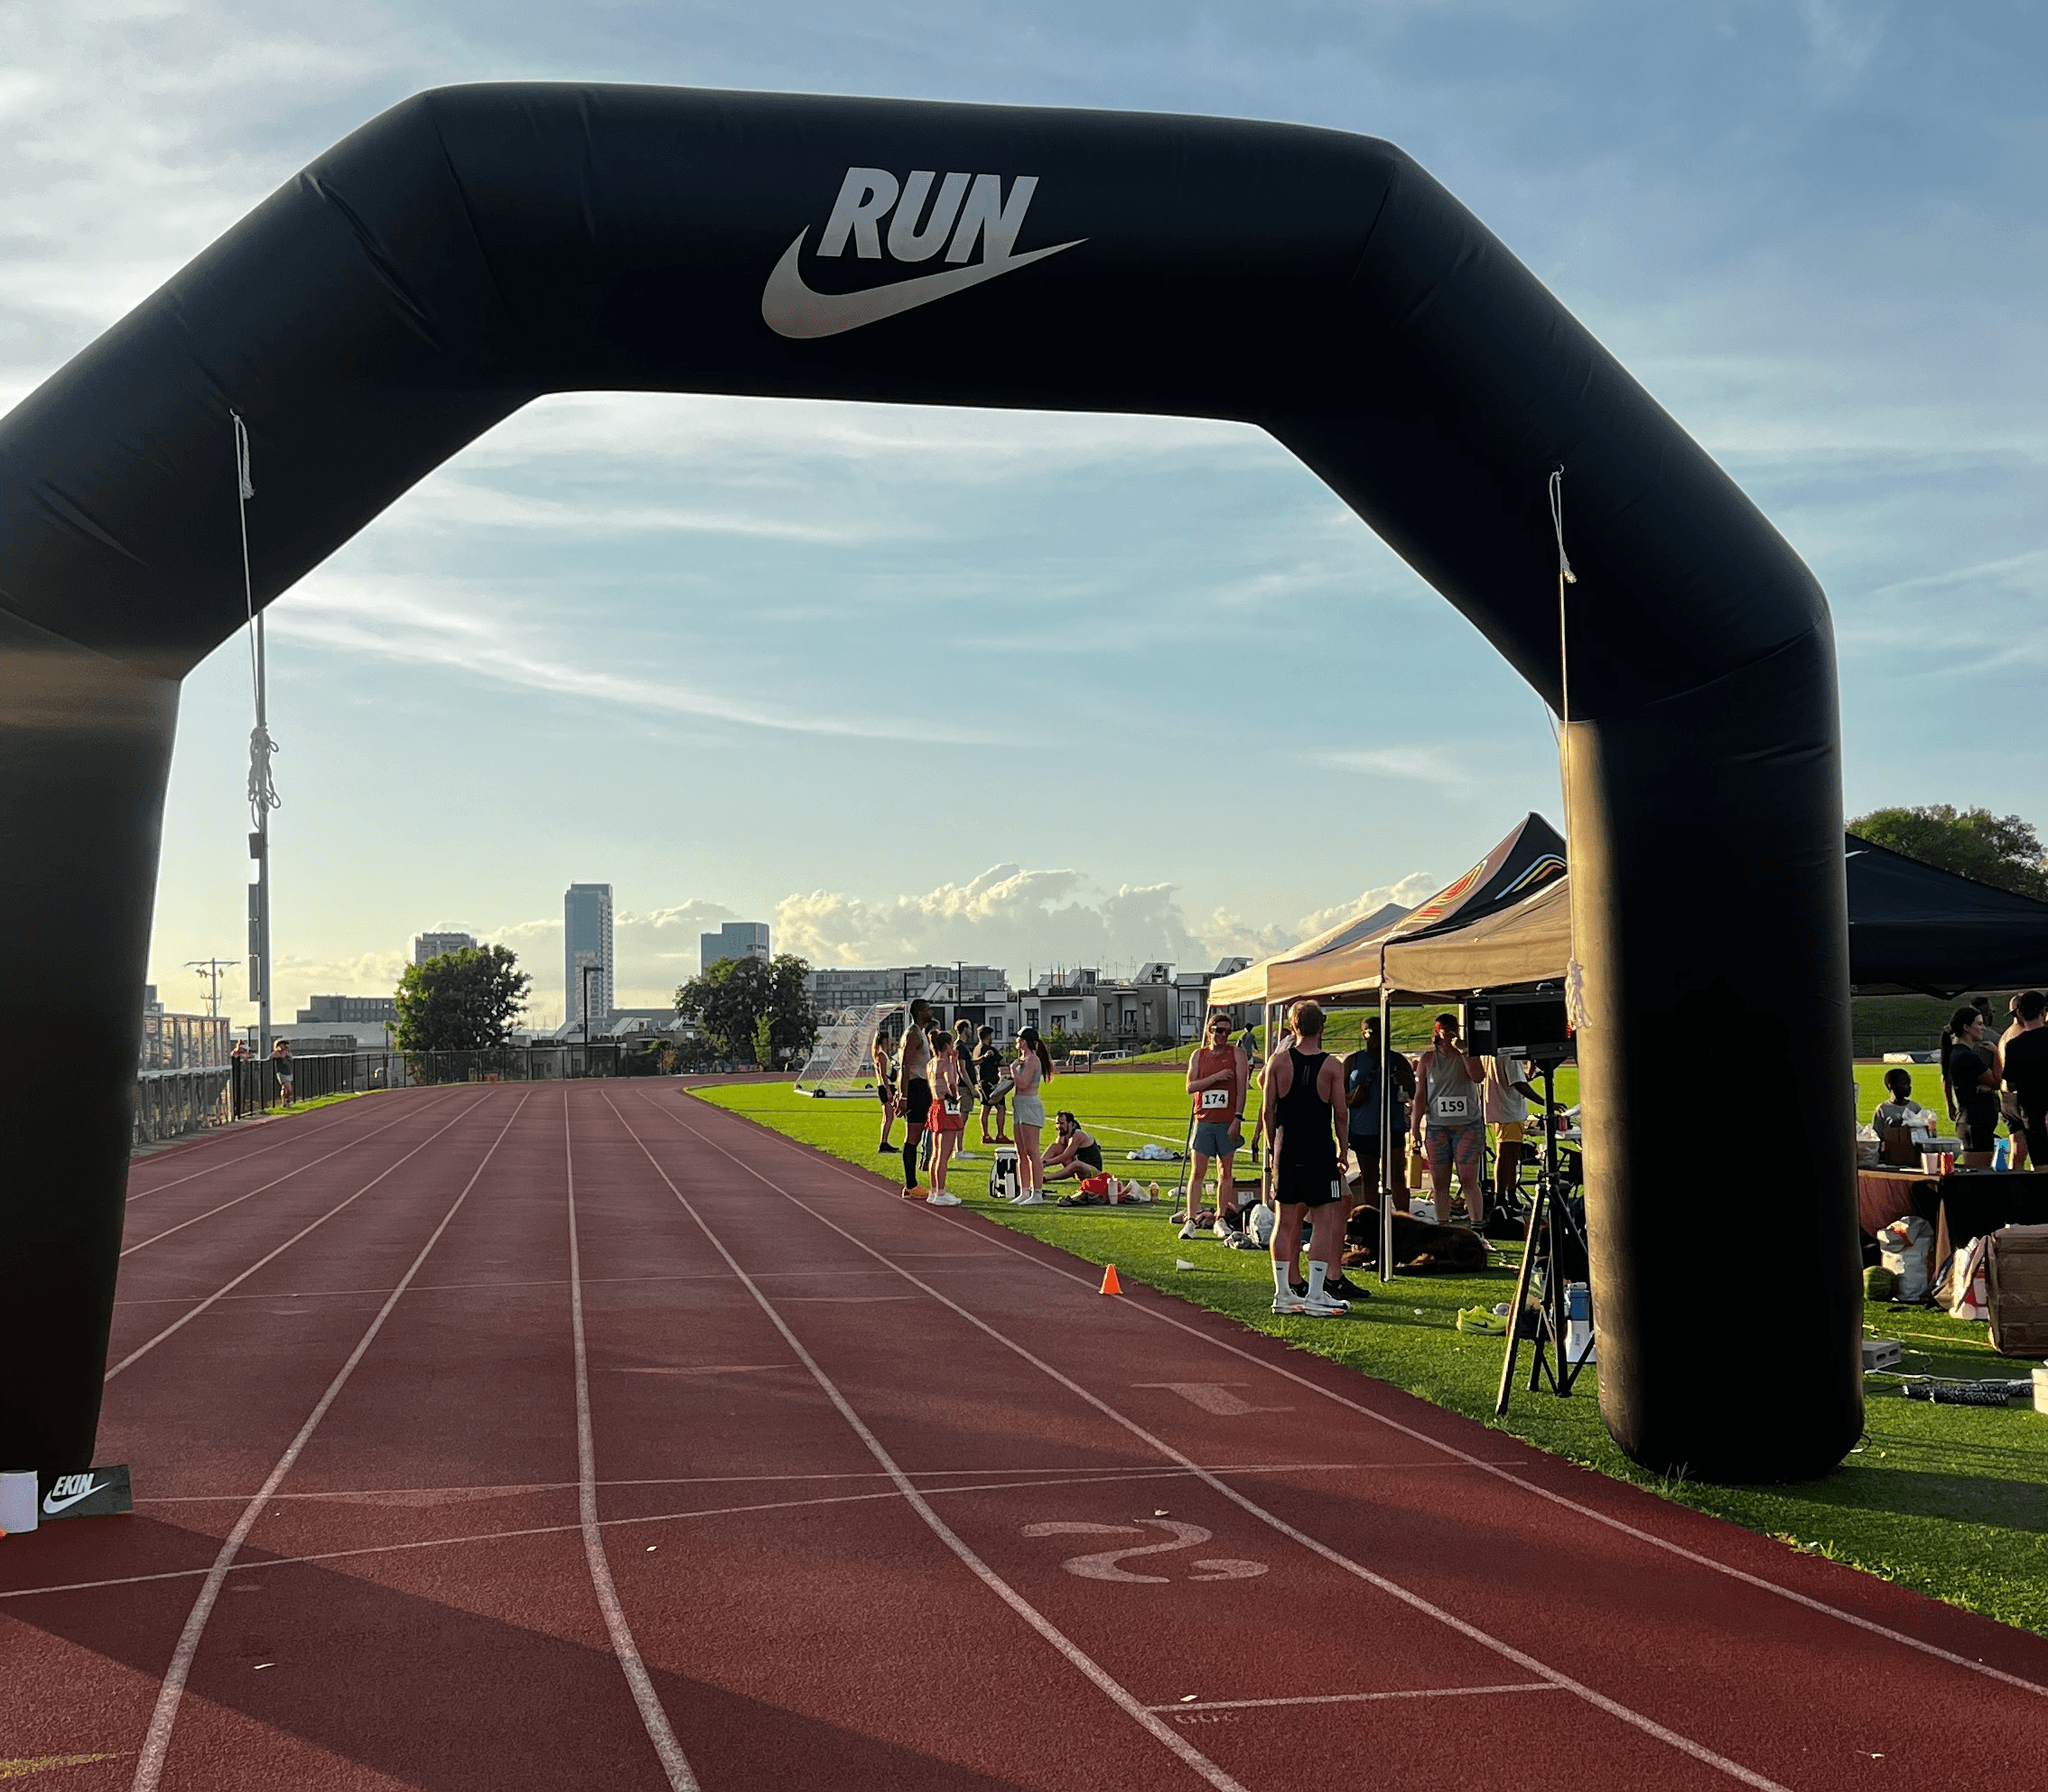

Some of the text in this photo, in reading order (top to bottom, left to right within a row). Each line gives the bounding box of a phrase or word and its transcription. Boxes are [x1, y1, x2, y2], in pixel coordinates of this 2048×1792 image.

[815, 166, 1039, 264] RUN
[1204, 1093, 1226, 1105] 174
[1440, 1100, 1465, 1113] 159
[51, 1472, 95, 1497] EKIN
